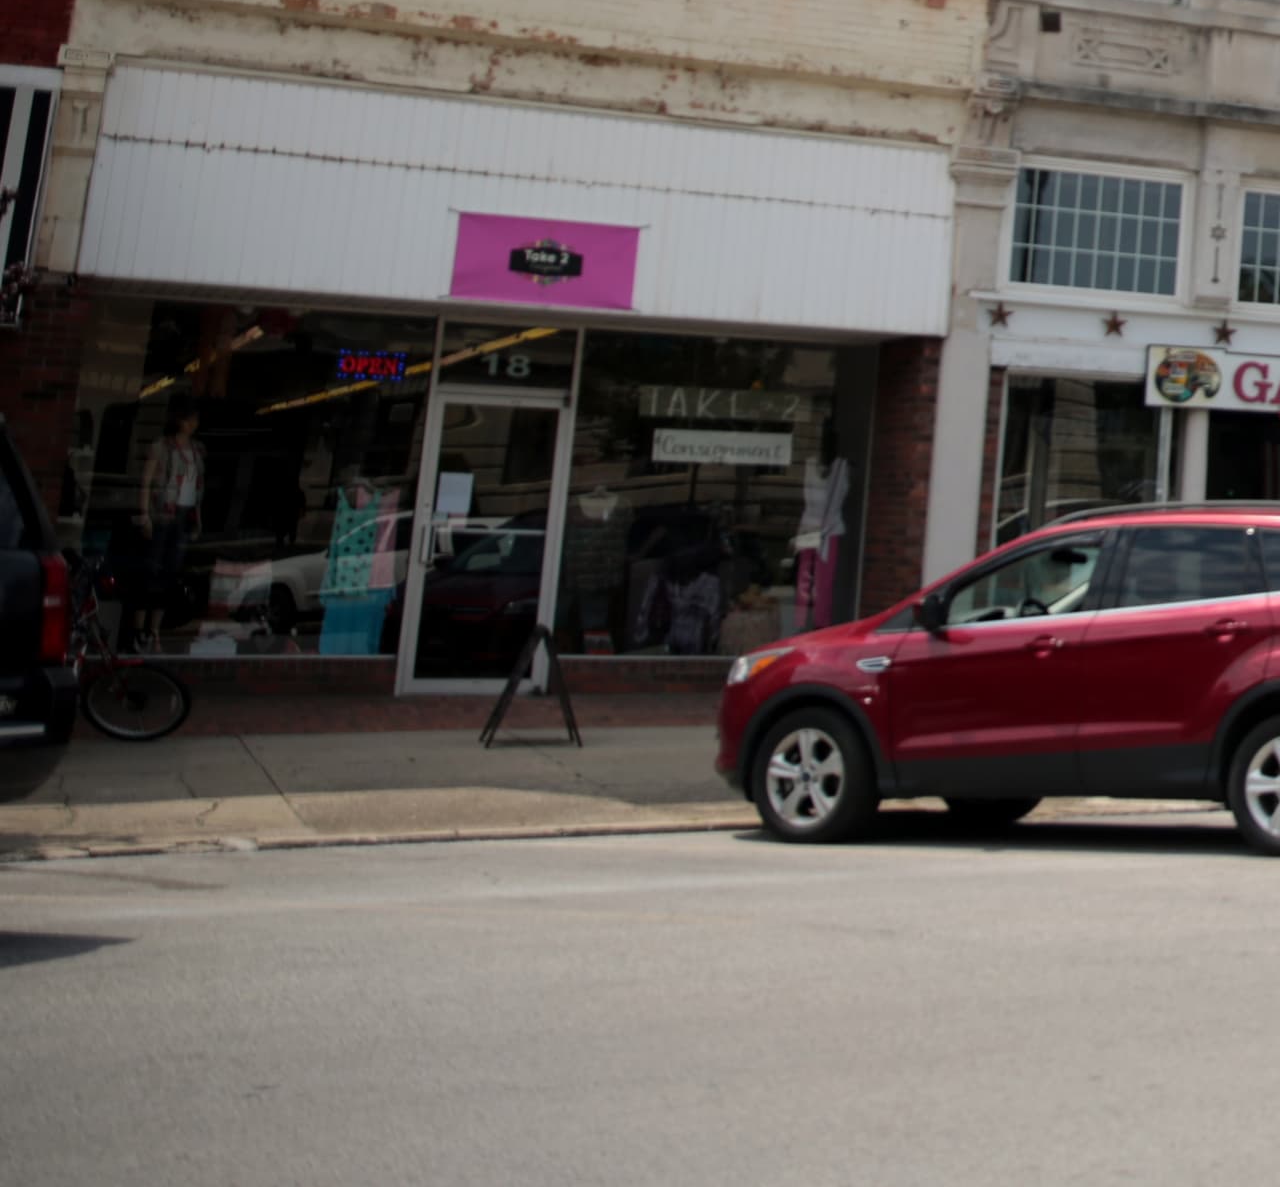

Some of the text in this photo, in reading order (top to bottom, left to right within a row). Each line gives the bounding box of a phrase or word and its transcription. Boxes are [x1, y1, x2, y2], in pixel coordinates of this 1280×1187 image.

[524, 249, 571, 265] Take 2
[341, 355, 398, 375] OPEN
[481, 353, 531, 378] 18
